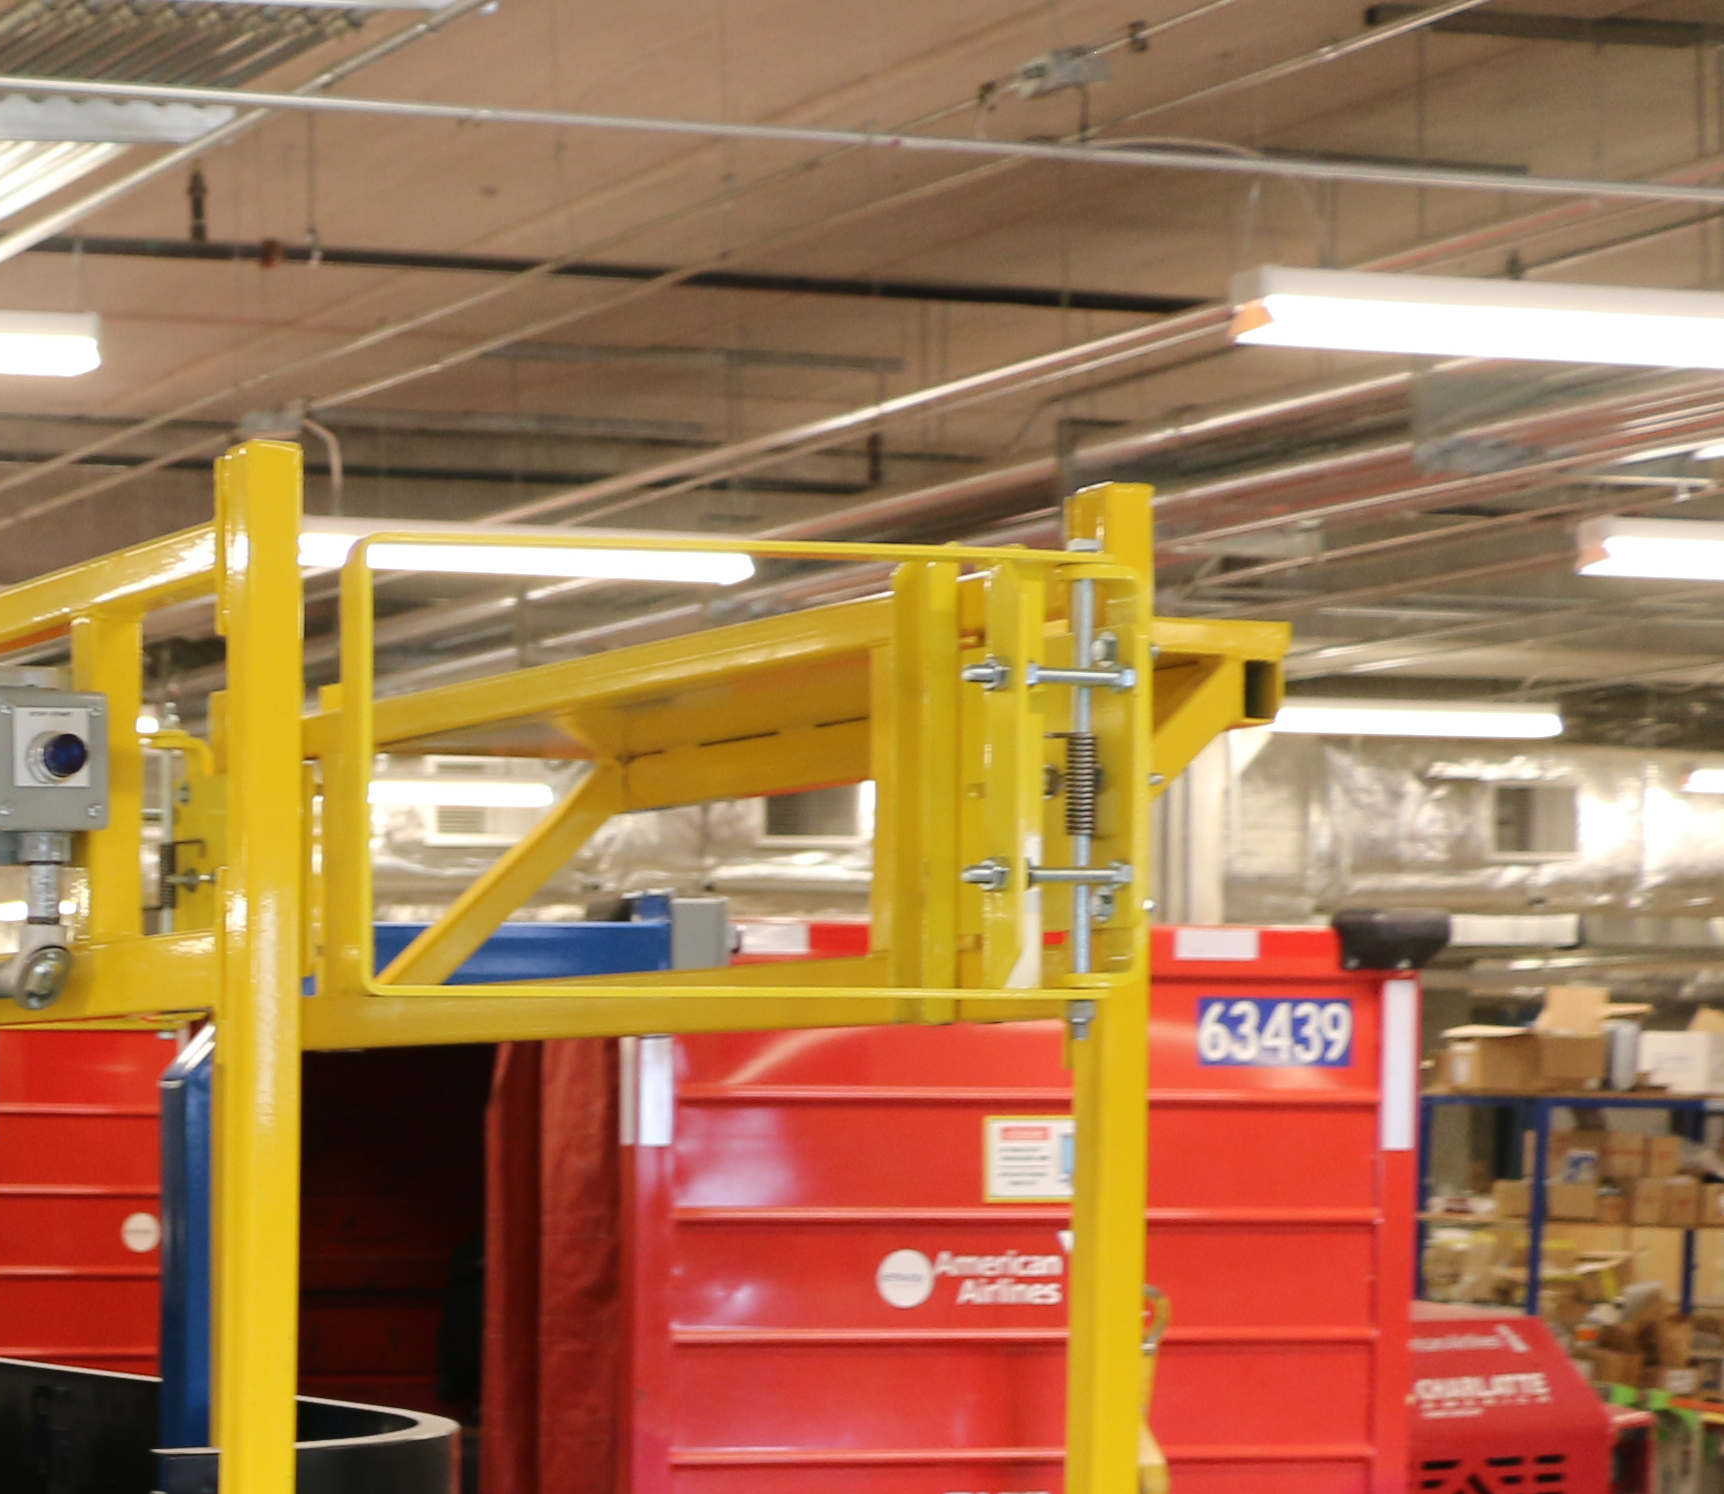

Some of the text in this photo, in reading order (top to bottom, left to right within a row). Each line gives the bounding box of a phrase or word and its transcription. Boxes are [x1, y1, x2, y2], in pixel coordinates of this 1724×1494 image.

[1198, 1000, 1352, 1063] 63439
[932, 1250, 1064, 1278] American
[955, 1278, 1064, 1306] Airlines
